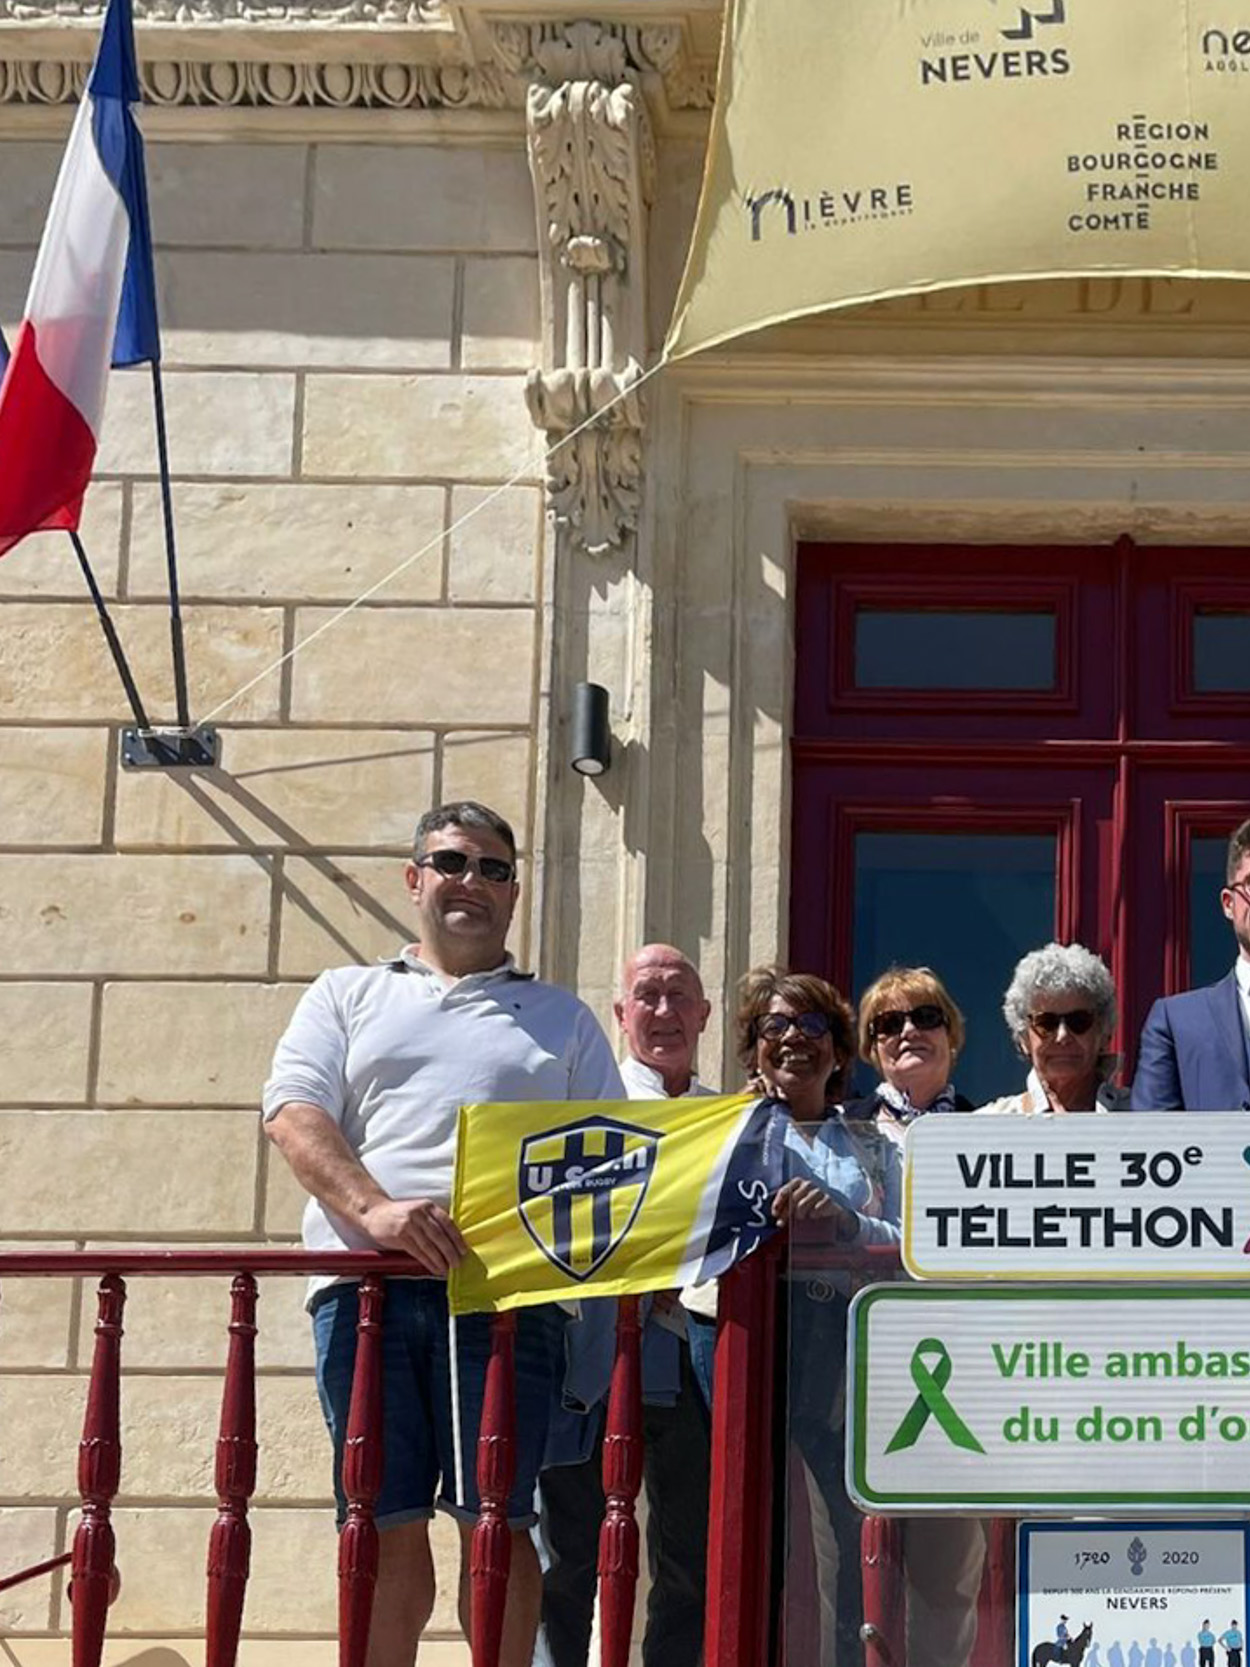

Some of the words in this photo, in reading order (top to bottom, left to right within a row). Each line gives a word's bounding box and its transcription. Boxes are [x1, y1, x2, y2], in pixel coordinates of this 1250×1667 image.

[920, 34, 956, 48] Ville
[959, 30, 980, 43] de
[921, 48, 1070, 84] NEVERS
[1067, 152, 1218, 172] BOURGOGNE
[1087, 182, 1200, 201] FRANCHE
[957, 1153, 1096, 1188] VILLE
[1120, 1146, 1204, 1188] 30e
[926, 1205, 1234, 1248] TÉLÉTHON
[991, 1342, 1090, 1378] Ville
[1002, 1406, 1059, 1442] du
[1075, 1406, 1162, 1442] don
[1074, 1551, 1111, 1571] 1720
[1162, 1551, 1199, 1565] 2020
[1106, 1597, 1168, 1610] NEVERS
